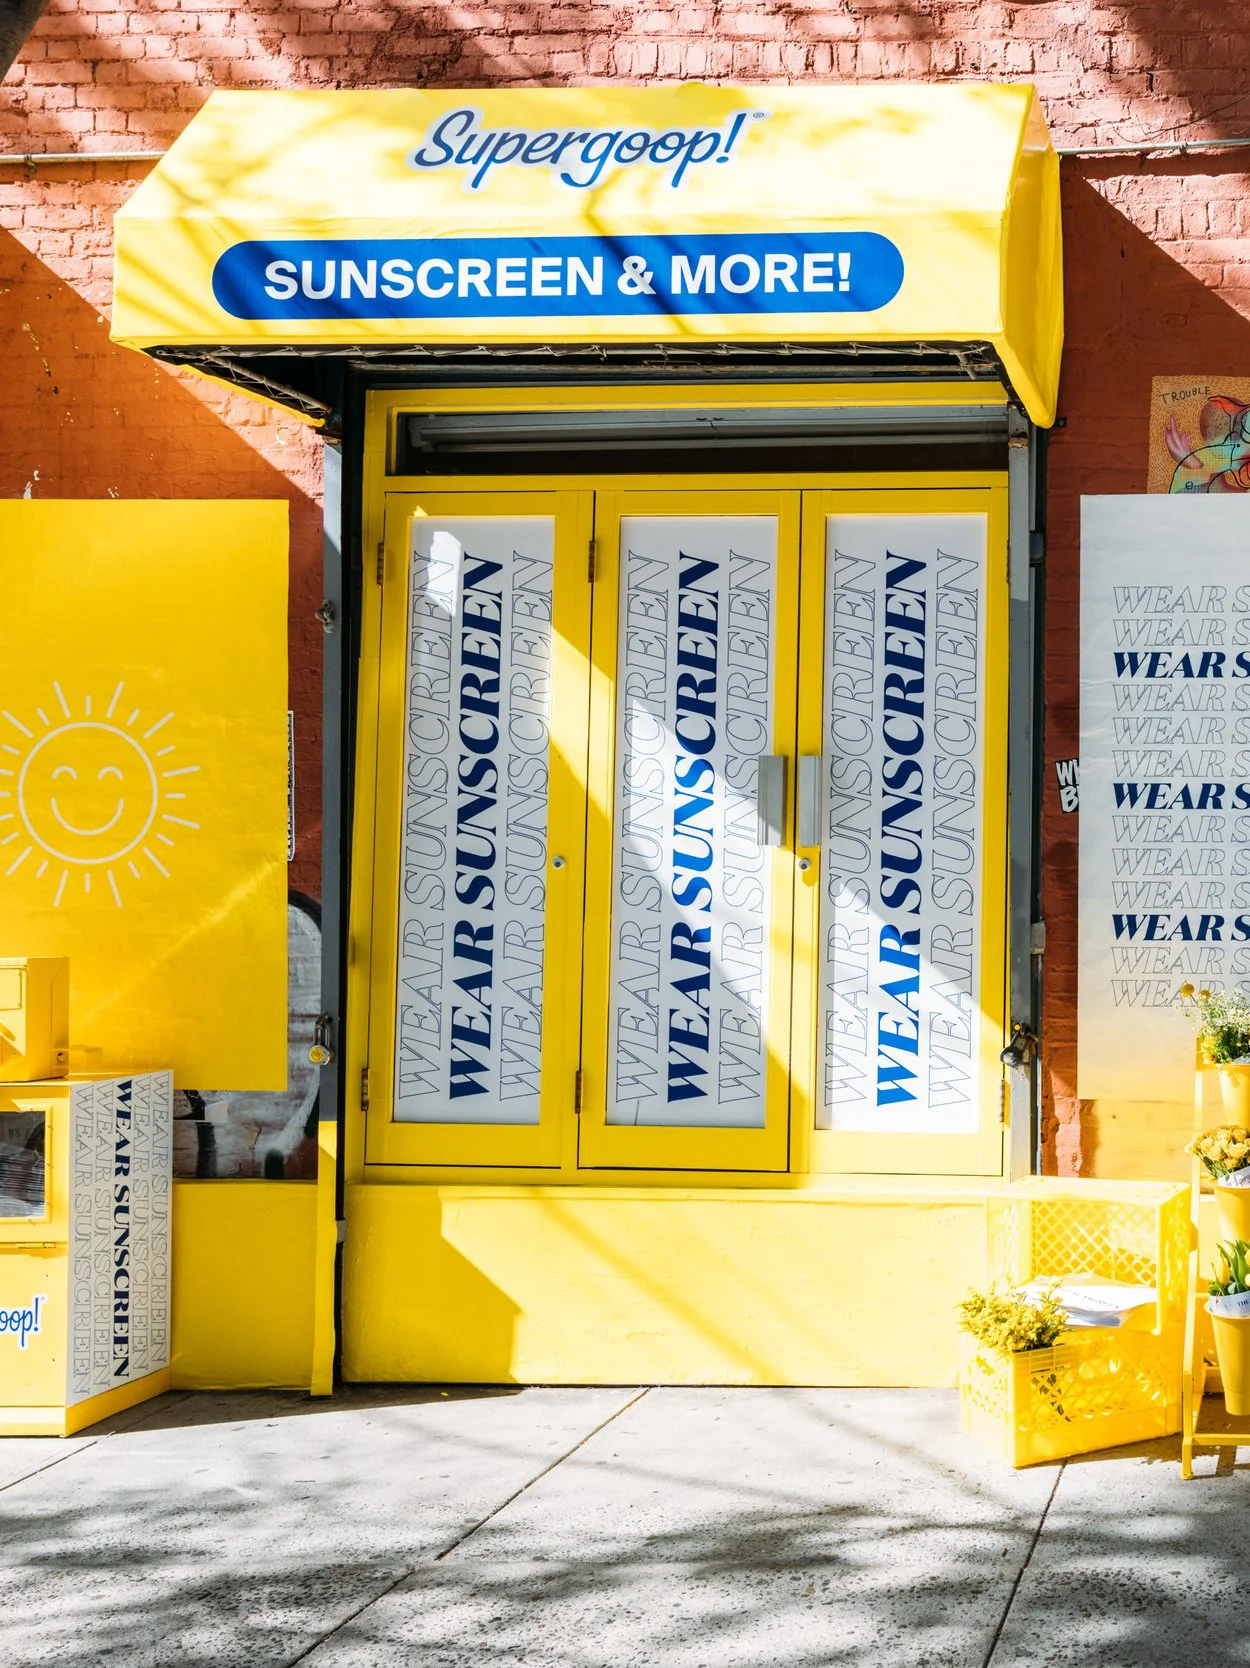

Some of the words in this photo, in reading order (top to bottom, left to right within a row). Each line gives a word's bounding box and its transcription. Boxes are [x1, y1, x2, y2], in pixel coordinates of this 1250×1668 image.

[414, 109, 747, 189] Supergoop!
[264, 255, 603, 300] SUNSCREEN
[617, 255, 656, 296] &
[671, 252, 852, 294] MORE!
[1159, 386, 1211, 404] TROUBLE
[1112, 584, 1226, 613] WEAR
[1112, 618, 1226, 646] WEAR
[1112, 651, 1226, 678] WEAR
[404, 549, 454, 912] SUNSCREEN
[455, 552, 504, 912] SUNSCREEN
[504, 550, 553, 912] SUNSCREEN
[621, 549, 669, 913] SUNSCREEN
[672, 550, 720, 913] SUNSCREEN
[722, 550, 770, 914] SUNSCREEN
[829, 550, 876, 914] SUNSCREEN
[879, 550, 927, 915] SUNSCREEN
[931, 549, 978, 916] SUNSCREEN
[1112, 684, 1226, 712] WEAR
[1112, 716, 1226, 745] WEAR
[1112, 750, 1226, 778] WEAR
[1112, 782, 1226, 810] WEAR
[1112, 815, 1226, 844] WEAR
[1112, 848, 1226, 877] WEAR
[1112, 881, 1226, 910] WEAR
[1112, 914, 1226, 943] WEAR
[1112, 946, 1226, 976] WEAR
[398, 919, 444, 1100] WEAR
[449, 920, 494, 1100] WEAR
[500, 919, 543, 1101] WEAR
[615, 919, 661, 1102] WEAR
[668, 920, 712, 1103] WEAR
[718, 921, 763, 1104] WEAR
[824, 922, 870, 1107] WEAR
[877, 923, 921, 1108] WEAR
[927, 922, 973, 1108] WEAR
[75, 1085, 94, 1188] WEAR
[95, 1082, 115, 1182] WEAR
[115, 1080, 132, 1177] WEAR
[133, 1076, 152, 1174] WEAR
[152, 1072, 170, 1168] WEAR
[74, 1194, 92, 1394] SUNSCREEN
[94, 1188, 111, 1386] SUNSCREEN
[113, 1184, 130, 1377] SUNSCREEN
[132, 1178, 149, 1370] SUNSCREEN
[151, 1174, 168, 1362] SUNSCREEN
